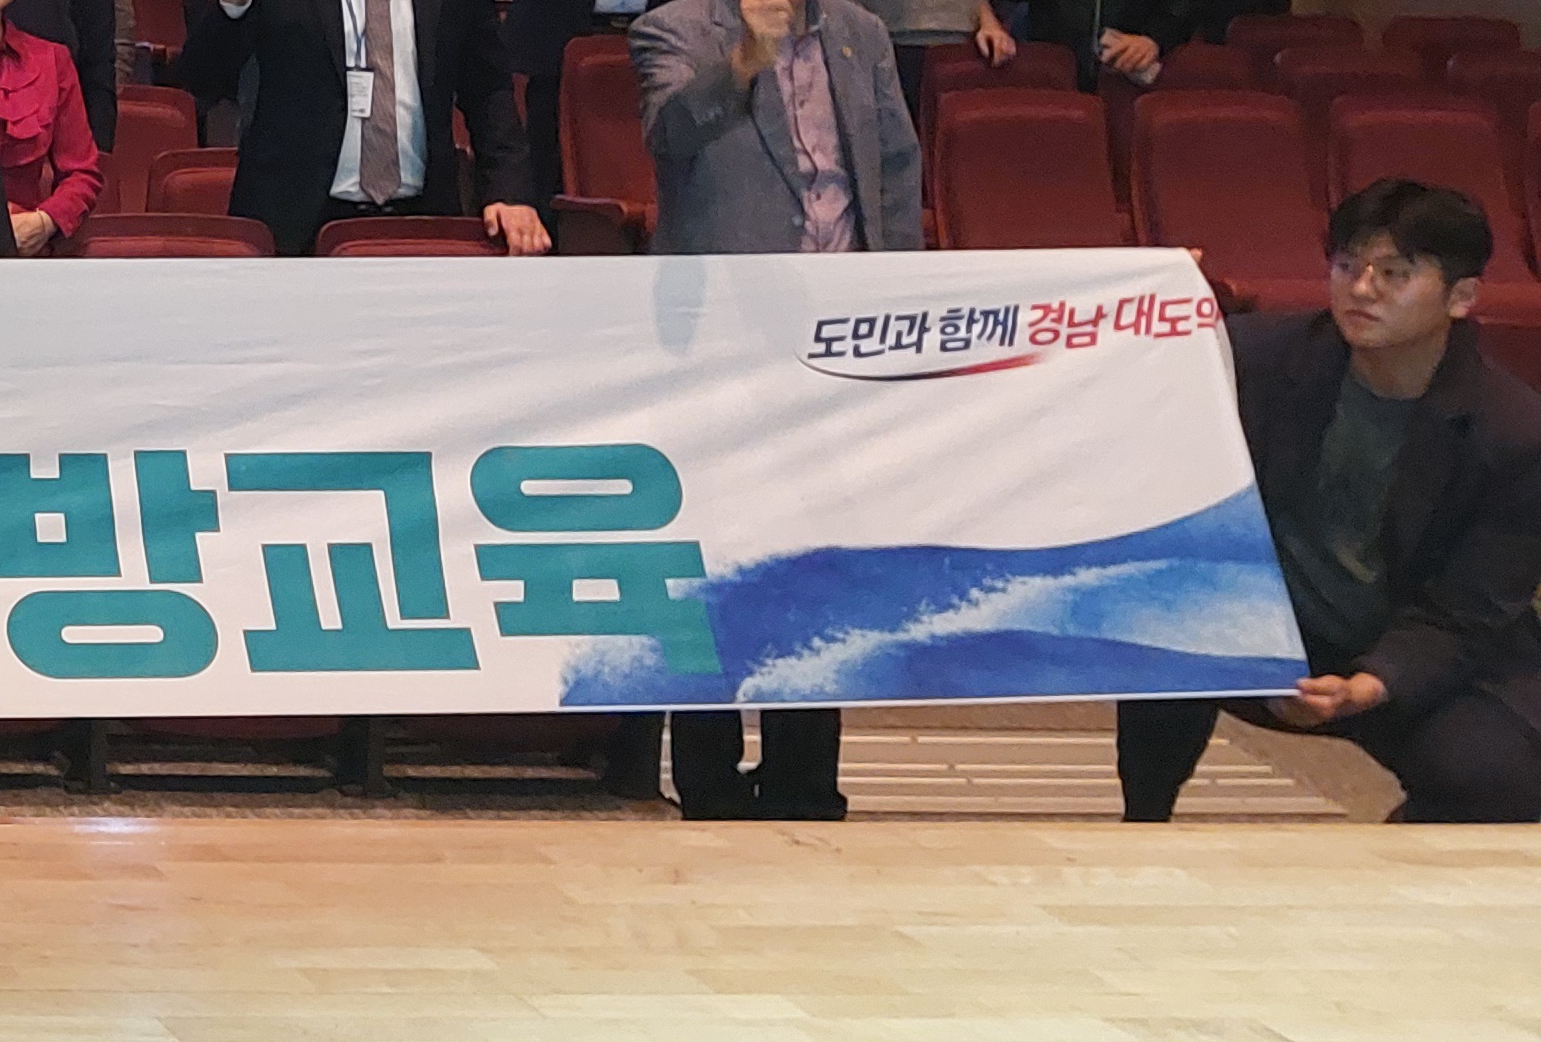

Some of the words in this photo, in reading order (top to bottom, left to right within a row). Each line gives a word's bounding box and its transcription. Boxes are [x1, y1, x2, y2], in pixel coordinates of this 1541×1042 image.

[807, 310, 930, 359] 도민과
[937, 304, 1019, 353] 함께
[1026, 300, 1109, 350] 경남
